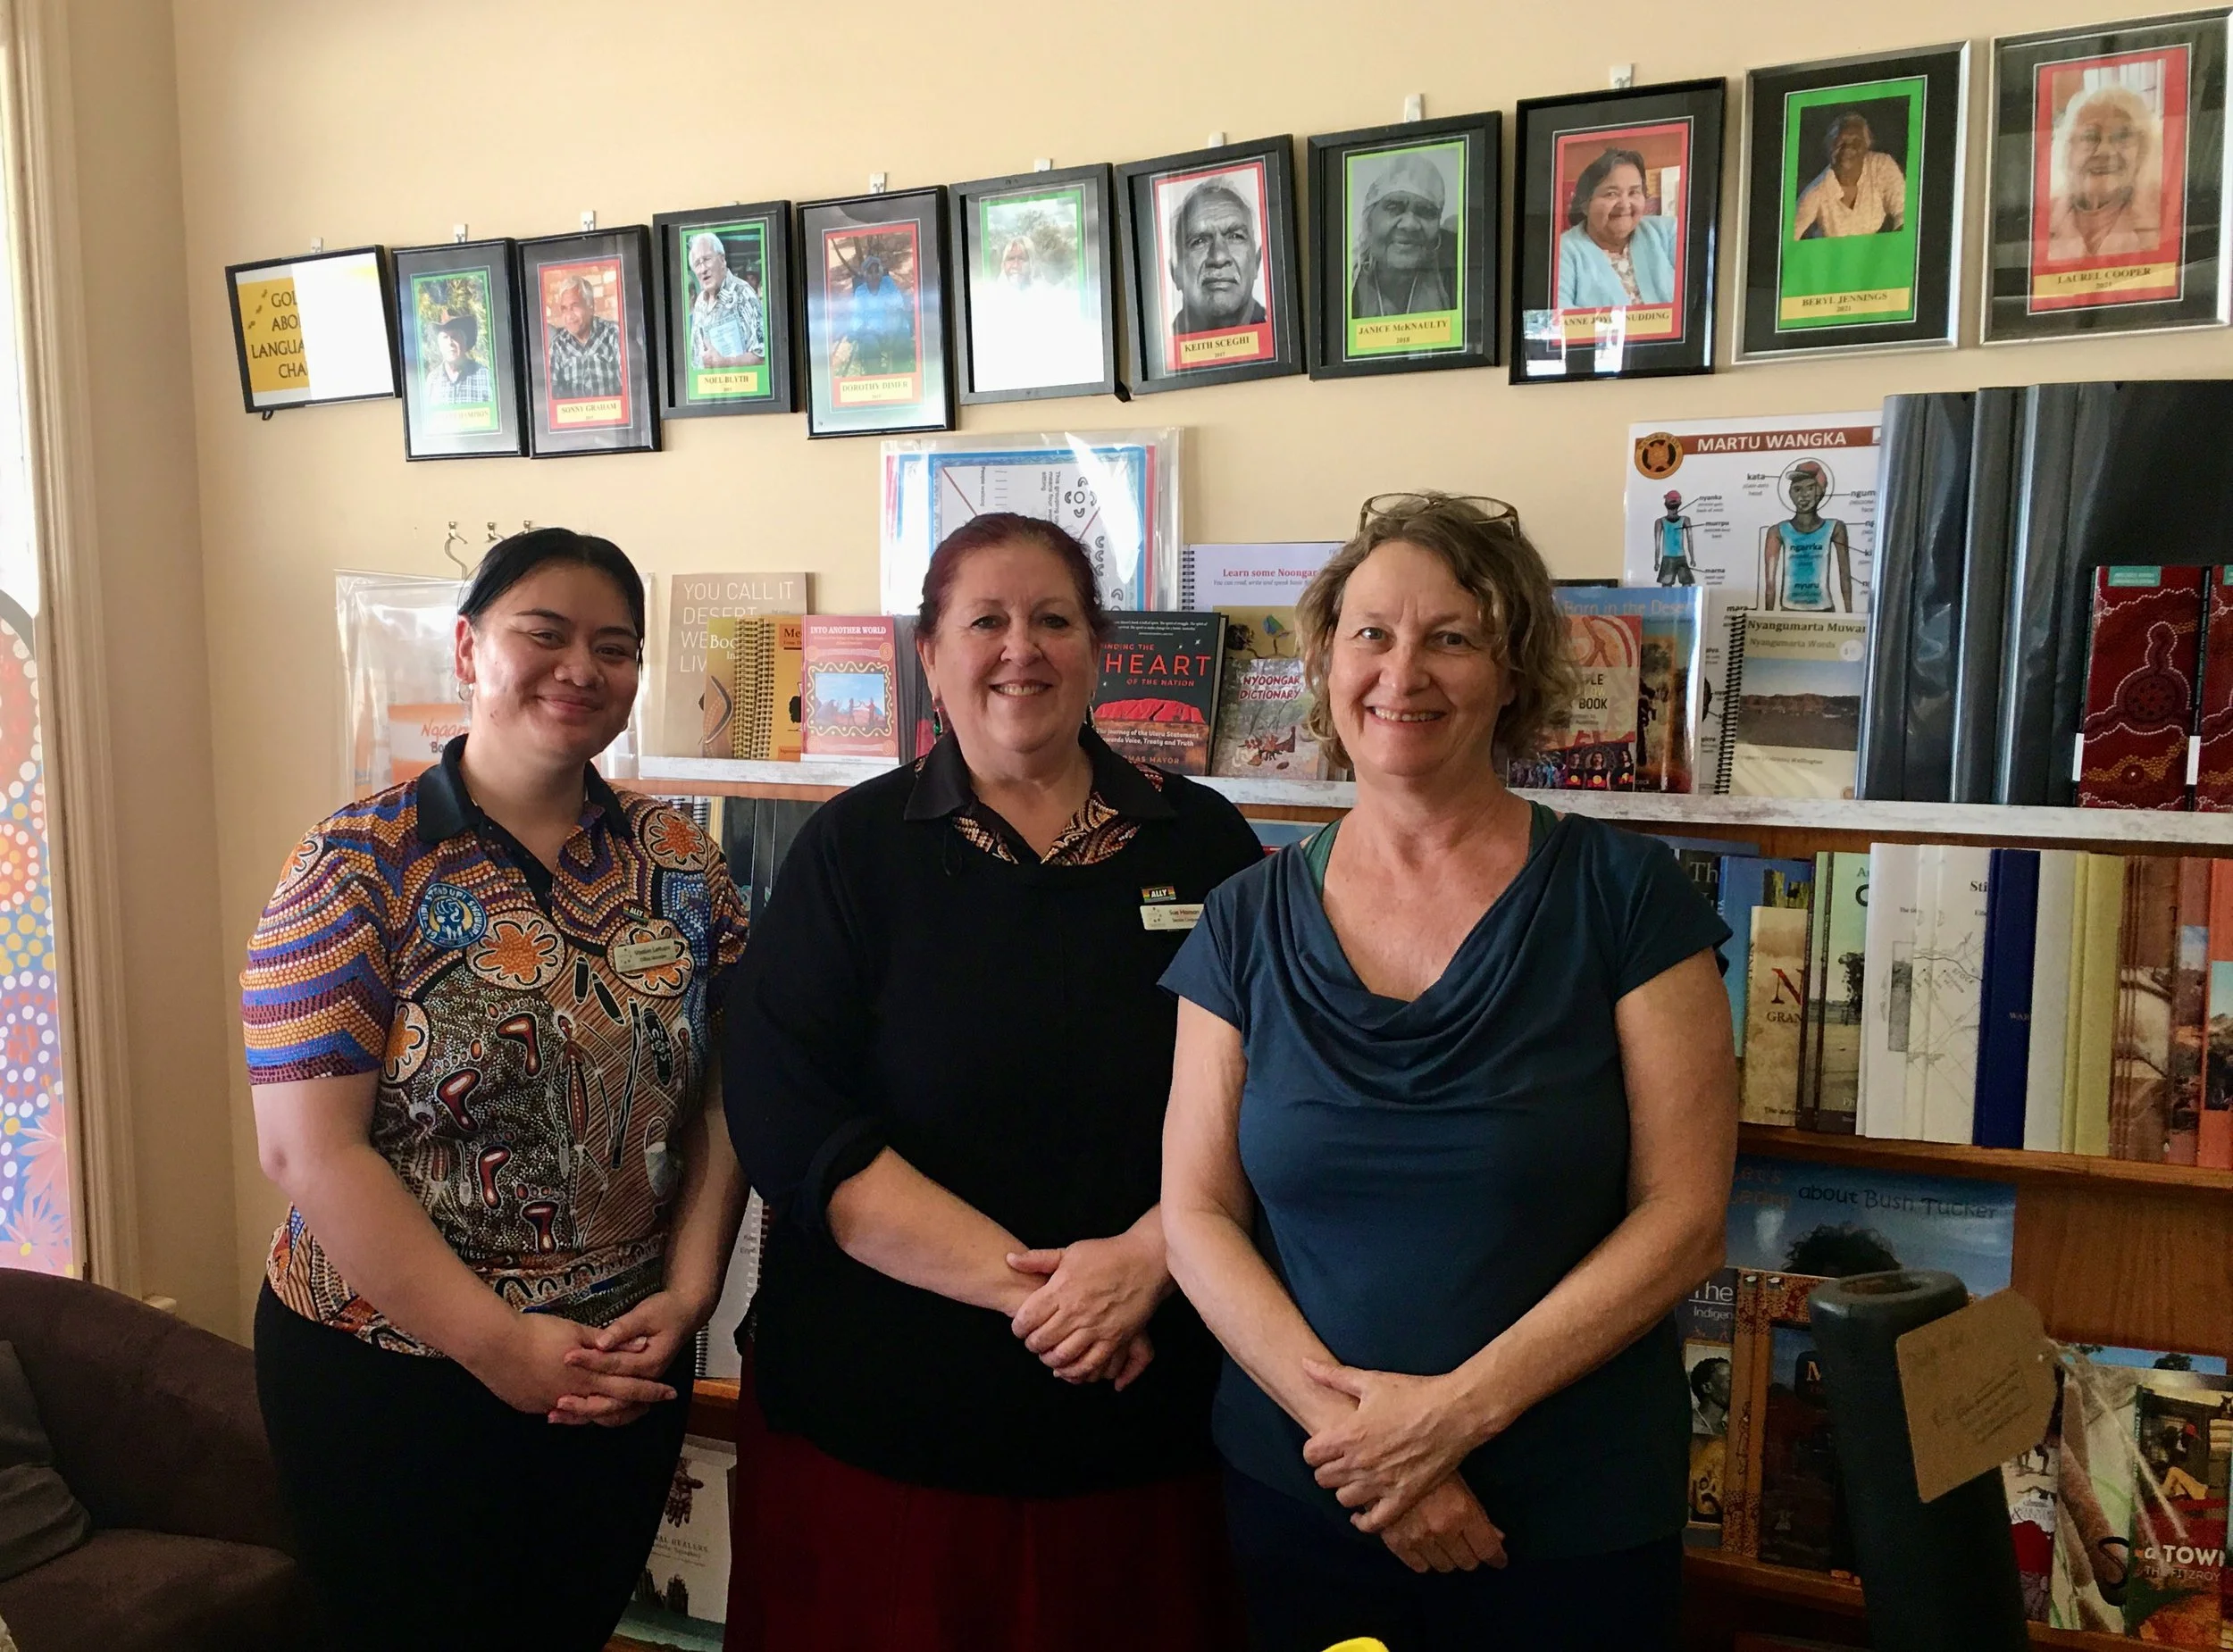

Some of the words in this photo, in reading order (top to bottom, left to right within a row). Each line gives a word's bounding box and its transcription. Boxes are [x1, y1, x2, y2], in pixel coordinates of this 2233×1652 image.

[2057, 272, 2103, 286] LAUREL
[2104, 267, 2152, 280] COOPER
[1802, 296, 1836, 307] BERYL
[1837, 291, 1888, 304] JENNINGS
[272, 313, 300, 331] ABO
[1626, 312, 1669, 322] NUDDING
[1358, 324, 1391, 336] JANICE
[1392, 320, 1449, 332] McKNAULTY
[1184, 337, 1214, 353] KEITH
[1214, 336, 1250, 348] SCEGHI
[704, 377, 724, 385] NOEL
[724, 375, 749, 383] BLYTH
[842, 382, 880, 392] DOROTHY
[882, 380, 908, 389] DIMER
[561, 405, 583, 413] SONNY
[585, 403, 617, 413] GRAHAM
[1698, 436, 1760, 452] MARTU
[1766, 431, 1847, 449] WANGKA
[1223, 569, 1250, 577] Learn
[1277, 568, 1317, 579] Noongar
[683, 582, 720, 600] YOU
[726, 581, 774, 600] CALL
[779, 581, 794, 600] IT
[810, 626, 828, 634] INTO
[828, 626, 861, 634] ANOTHER
[861, 626, 887, 634] WORLD
[1747, 620, 1824, 633] Nyangumarta
[1138, 643, 1154, 651] THE
[1104, 653, 1211, 677] HEART
[1242, 675, 1300, 686] NYOONGAR
[1240, 688, 1301, 699] DICTIONARY
[1578, 697, 1608, 710] BOOK
[1166, 730, 1200, 739] Statement
[1143, 738, 1164, 747] Treaty
[1176, 738, 1194, 747] Truth
[1856, 867, 1869, 877] A
[1151, 889, 1167, 898] ALLY
[629, 907, 643, 917] ALLY
[1798, 1185, 1858, 1204] about
[1863, 1189, 1916, 1211] Bush
[1919, 1197, 1997, 1219] Tucker
